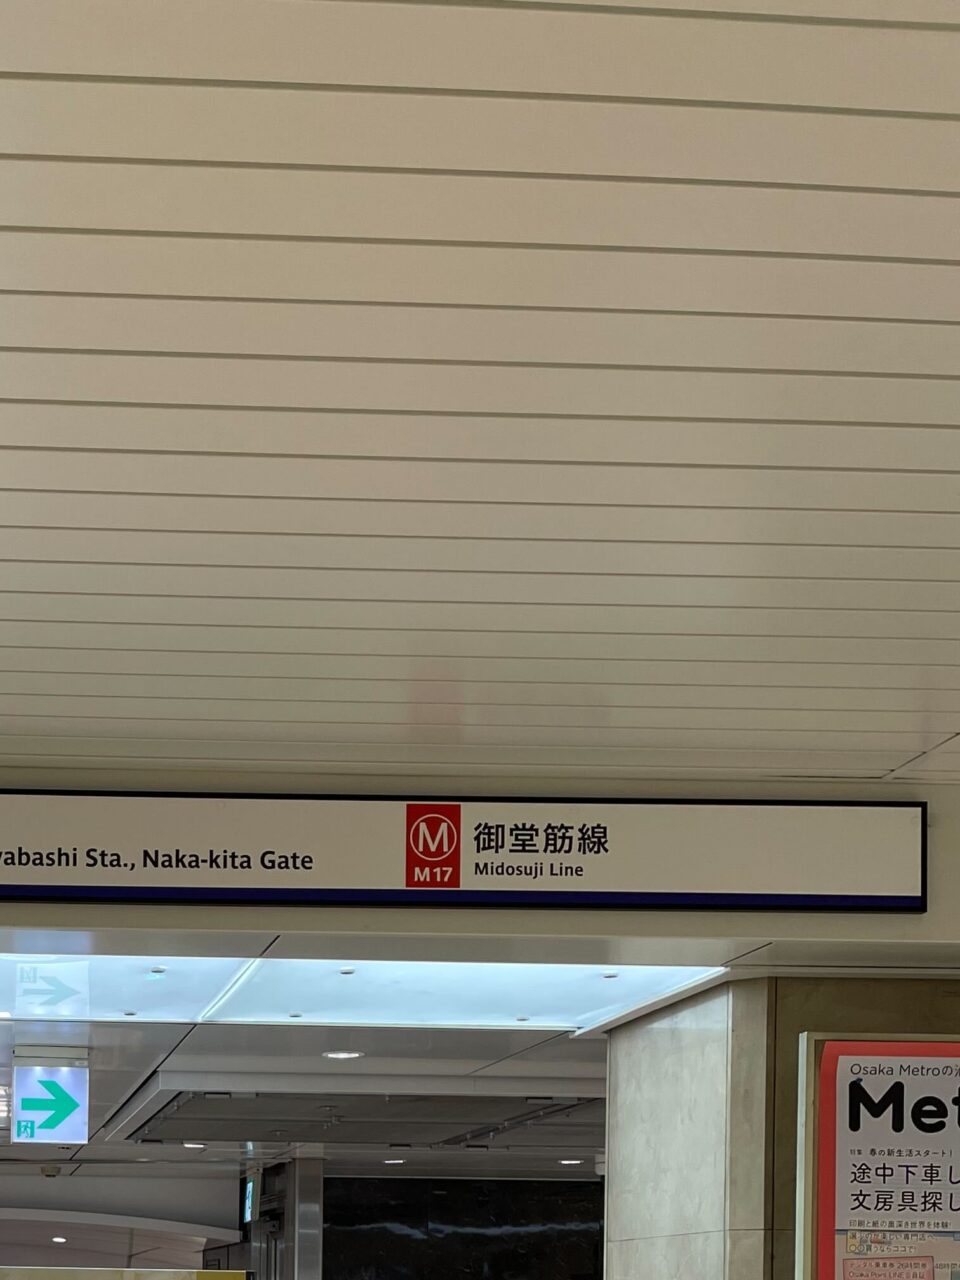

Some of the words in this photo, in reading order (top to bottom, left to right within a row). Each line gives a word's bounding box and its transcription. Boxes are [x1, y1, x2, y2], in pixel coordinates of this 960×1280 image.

[417, 822, 450, 853] M
[473, 821, 609, 855] 御堂筋線
[85, 847, 136, 870] Sta.,
[143, 848, 252, 870] Naka-kita
[260, 850, 313, 870] Gate
[413, 867, 453, 883] M17
[474, 861, 543, 879] Midosuji
[549, 863, 584, 878] Line
[850, 1063, 894, 1076] Osaka
